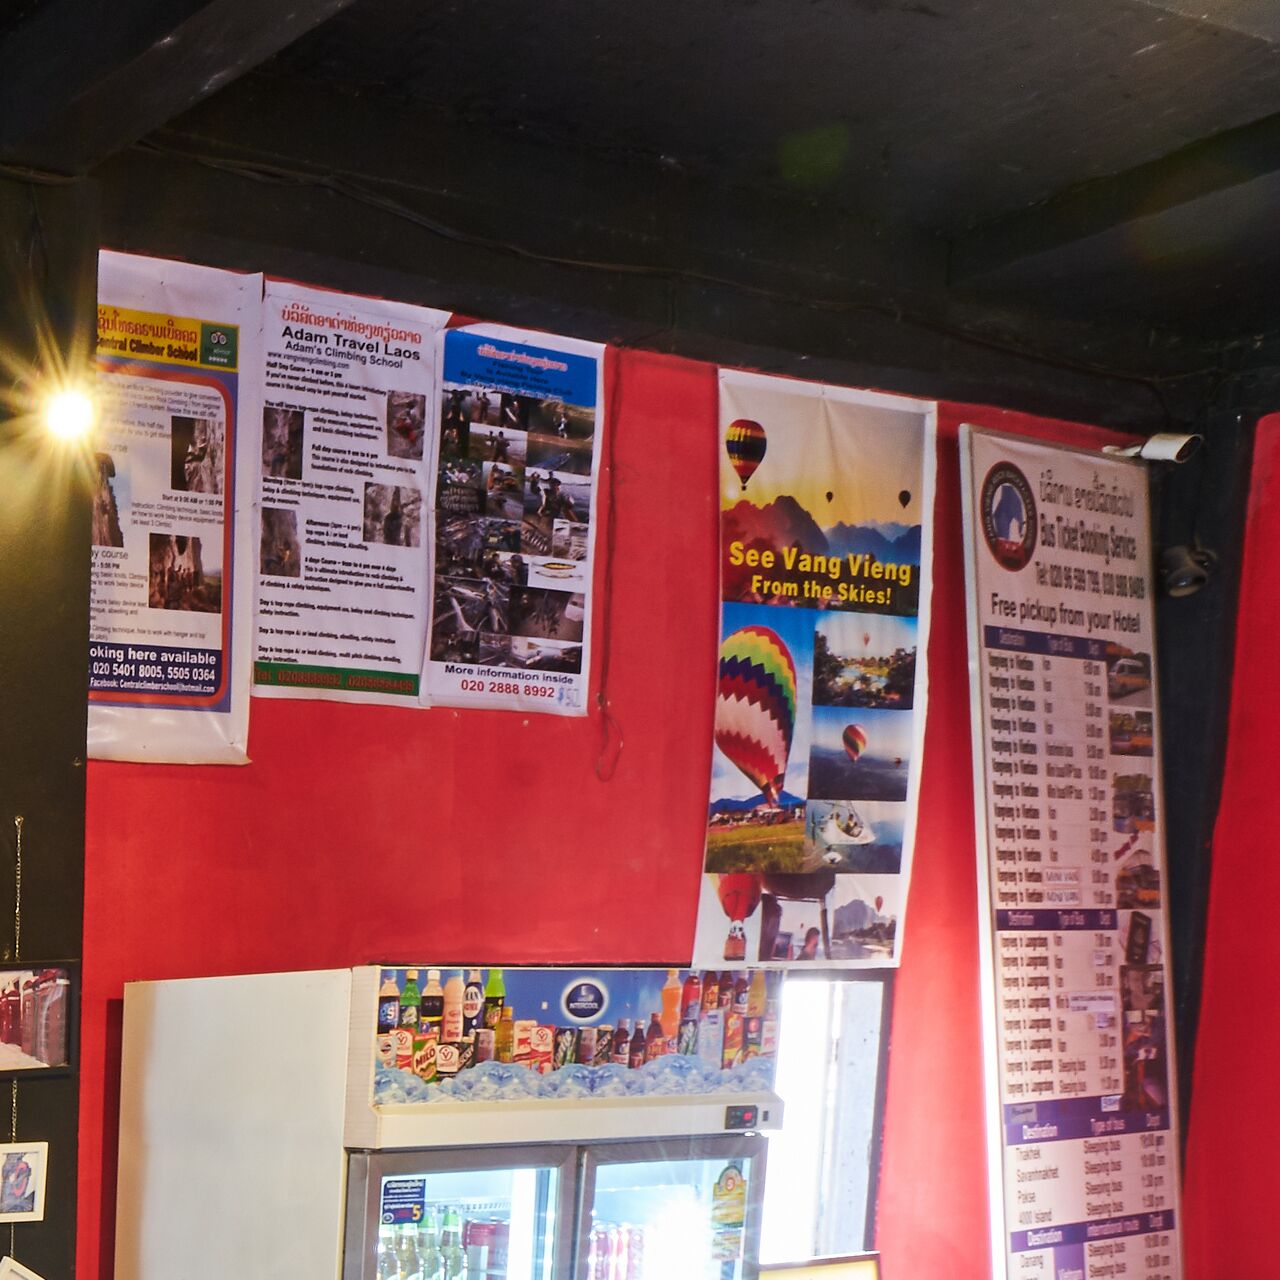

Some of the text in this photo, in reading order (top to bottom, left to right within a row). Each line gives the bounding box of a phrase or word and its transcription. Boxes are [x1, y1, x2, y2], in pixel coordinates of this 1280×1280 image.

[281, 325, 421, 361] Adam Travel Laos
[285, 341, 403, 369] Adam's Climbing School
[729, 541, 912, 587] See Vang Vieng
[751, 574, 892, 605] From the Skies!
[991, 592, 1017, 618] Free
[93, 662, 110, 675] 020
[128, 648, 157, 661] here
[160, 651, 216, 665] available
[444, 664, 574, 685] More information inside
[461, 679, 555, 698] 020 2888 8992
[415, 1045, 437, 1067] MILO
